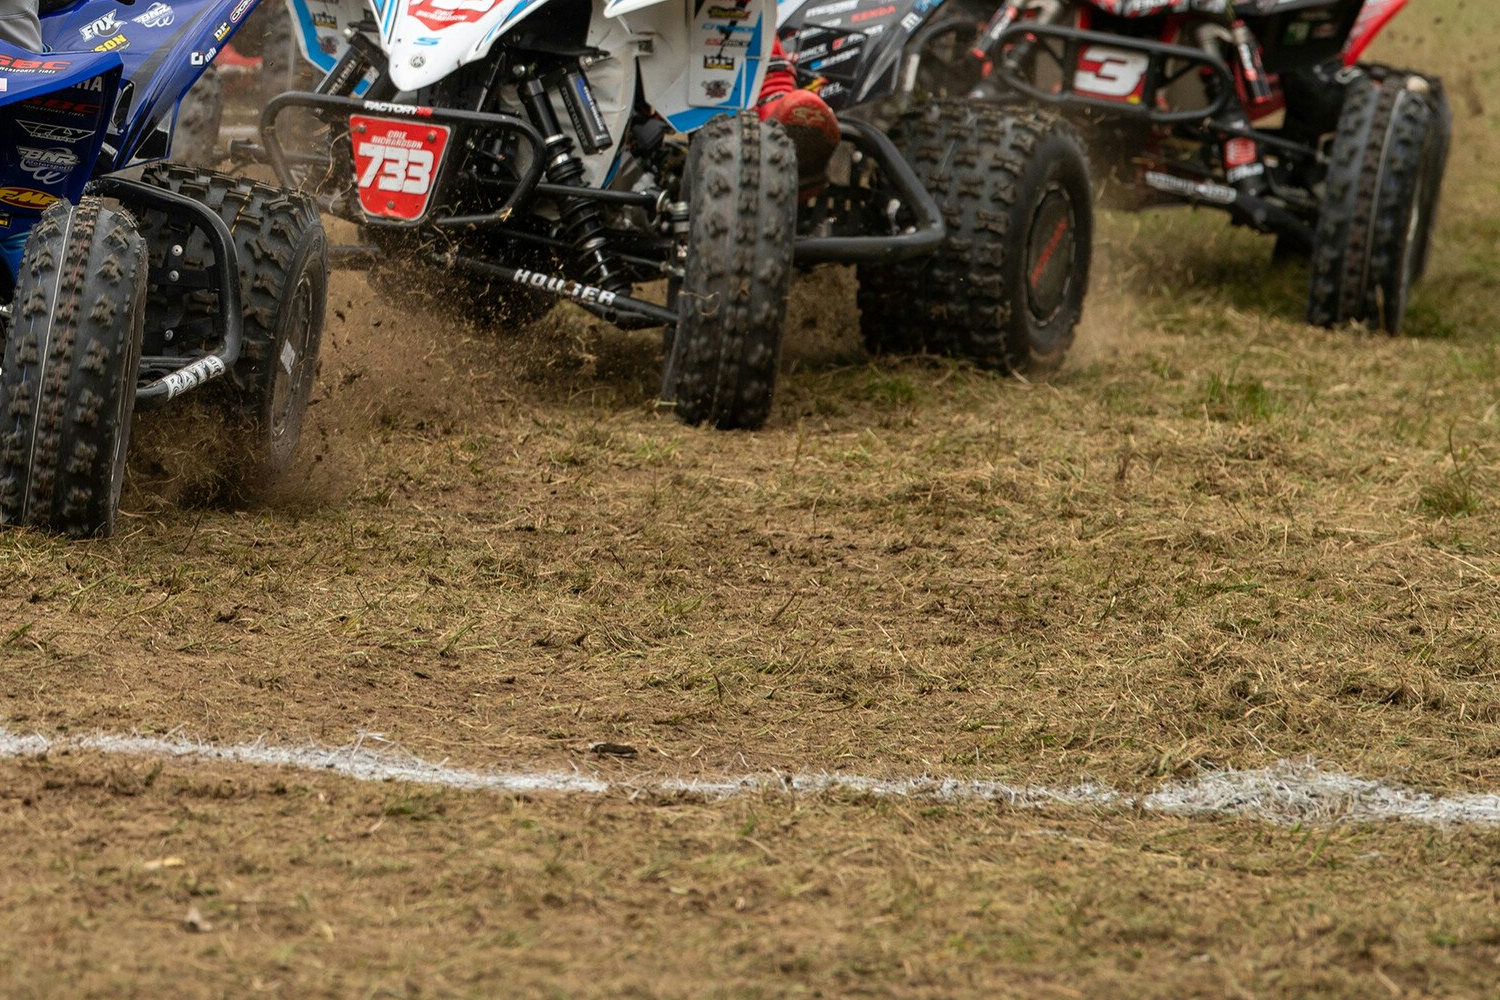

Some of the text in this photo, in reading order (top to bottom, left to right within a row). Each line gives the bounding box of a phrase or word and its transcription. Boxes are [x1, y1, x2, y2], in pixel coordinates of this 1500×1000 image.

[79, 10, 118, 42] FOX
[1073, 48, 1150, 97] 3
[364, 100, 418, 116] FACTORY
[22, 149, 80, 166] BNR
[371, 136, 424, 151] RICHARDSON
[358, 142, 435, 196] 733
[512, 268, 618, 306] HOUSER
